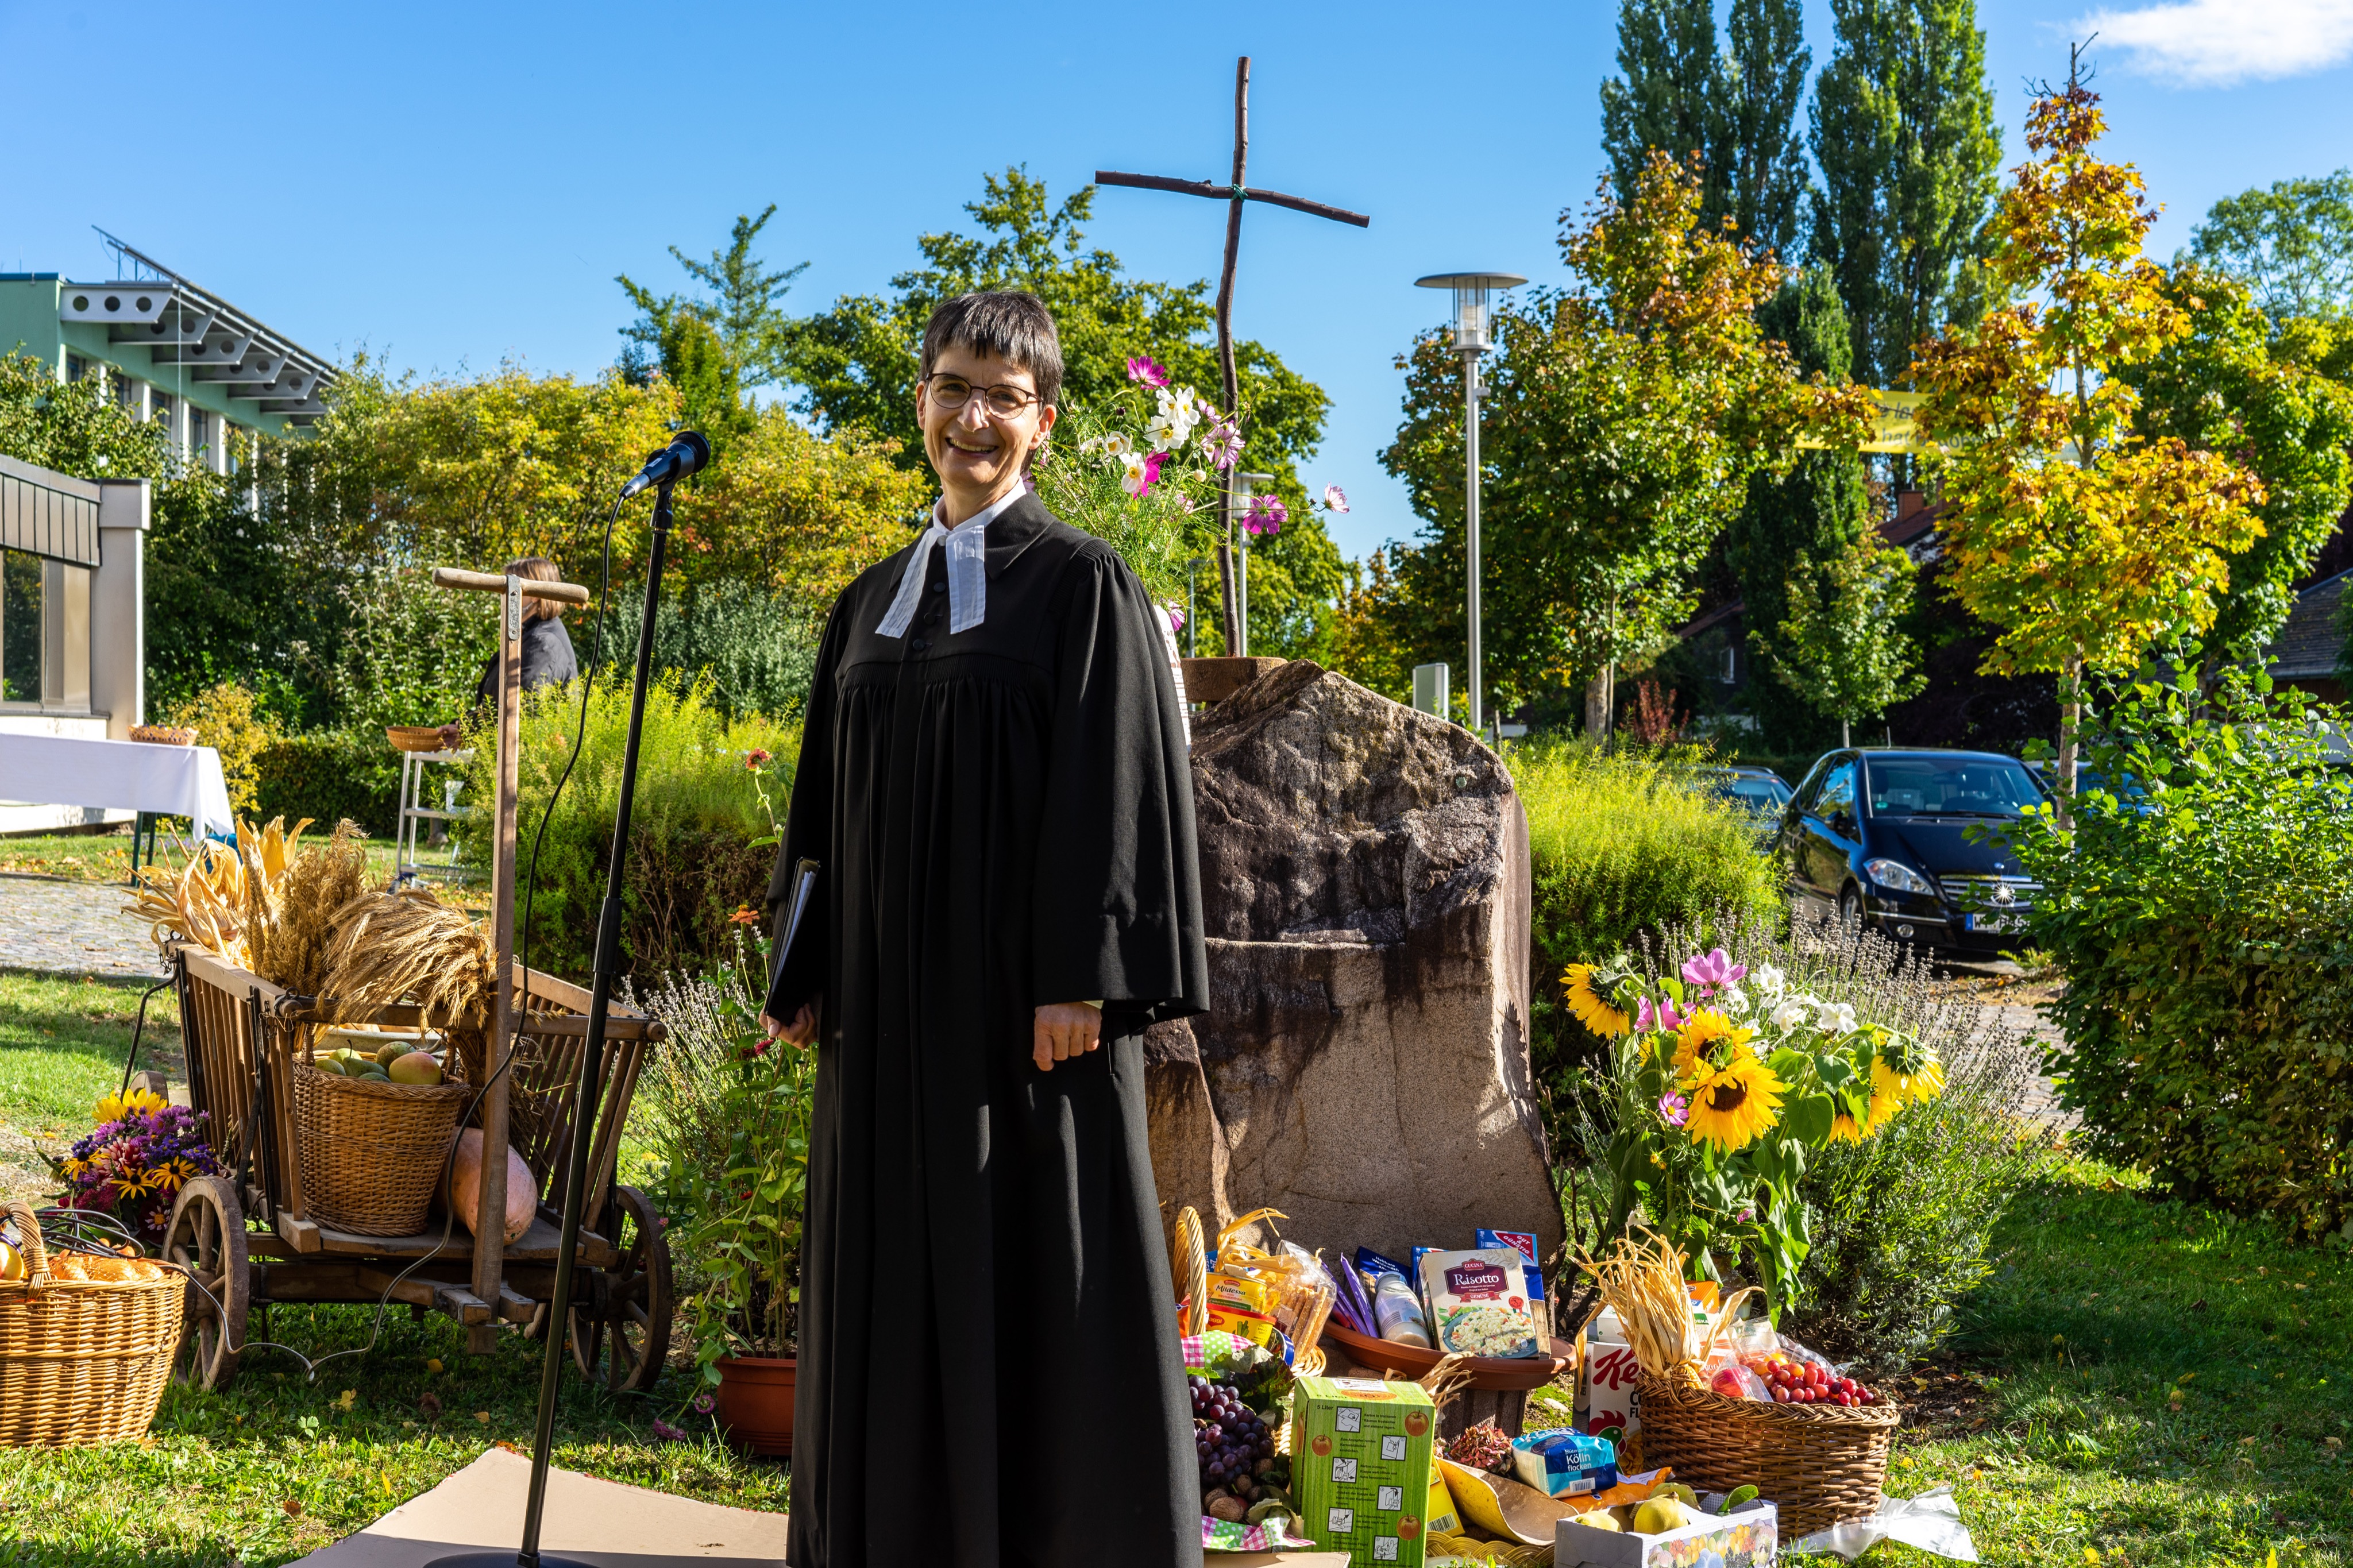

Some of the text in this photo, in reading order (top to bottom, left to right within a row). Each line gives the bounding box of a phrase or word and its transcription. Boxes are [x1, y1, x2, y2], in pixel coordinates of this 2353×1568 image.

[1503, 1235, 1530, 1254] GÜNSTIG
[1517, 1235, 1530, 1245] GUT
[1372, 1258, 1399, 1272] Weidemilch
[1376, 1256, 1395, 1268] Haltbare
[1453, 1273, 1499, 1285] Risotto
[1216, 1284, 1246, 1296] Mildessa
[1592, 1348, 1646, 1391] Ke
[1566, 1453, 1591, 1465] Kölln
[1568, 1463, 1591, 1472] flocken
